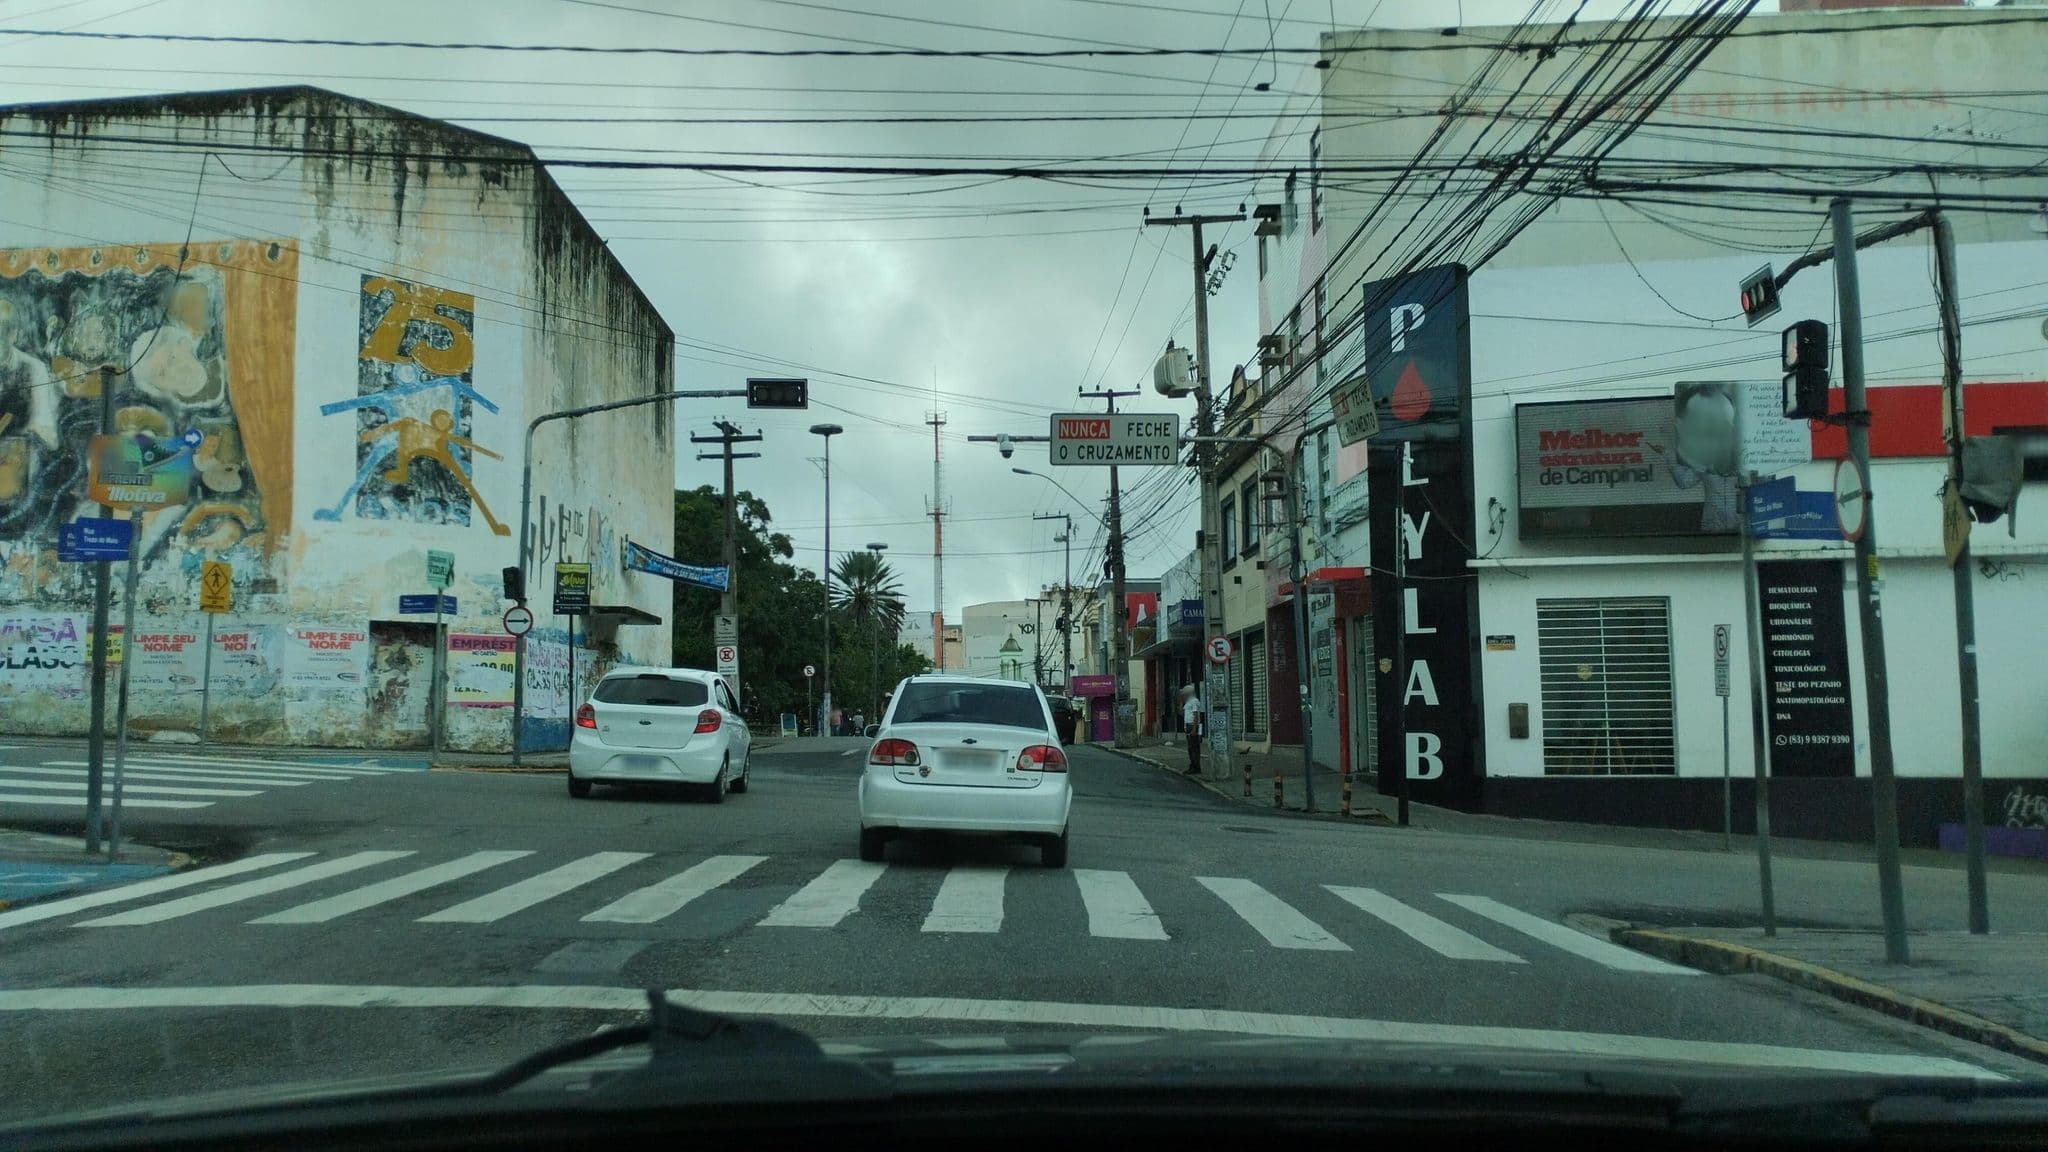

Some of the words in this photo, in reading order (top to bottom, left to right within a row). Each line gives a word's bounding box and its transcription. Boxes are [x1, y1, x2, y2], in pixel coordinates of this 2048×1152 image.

[1060, 422, 1108, 437] NUNCA
[1127, 422, 1171, 437] FECHE
[1539, 429, 1643, 450] Melhor
[1059, 445, 1068, 460] O
[1077, 445, 1170, 460] CRUZAMENTO
[1540, 453, 1643, 467] estrutura
[1540, 468, 1563, 485] de
[1566, 464, 1653, 488] Campina!
[1768, 586, 1818, 594] HEMATOLOGIA
[133, 634, 170, 643] LIMPE
[172, 634, 196, 643] SEU
[297, 631, 337, 640] LIMPE
[340, 632, 365, 642] SEU
[143, 643, 184, 652] NOME
[309, 640, 352, 650] NOME
[1772, 649, 1811, 657] CITOLOGIA
[1774, 664, 1826, 672] TOXICOLÓGICO
[1776, 695, 1845, 704] ANATOMOPATOLÓGICO
[1789, 735, 1804, 745] (83)
[1805, 735, 1811, 744] 9
[1831, 735, 1850, 744] 9390
